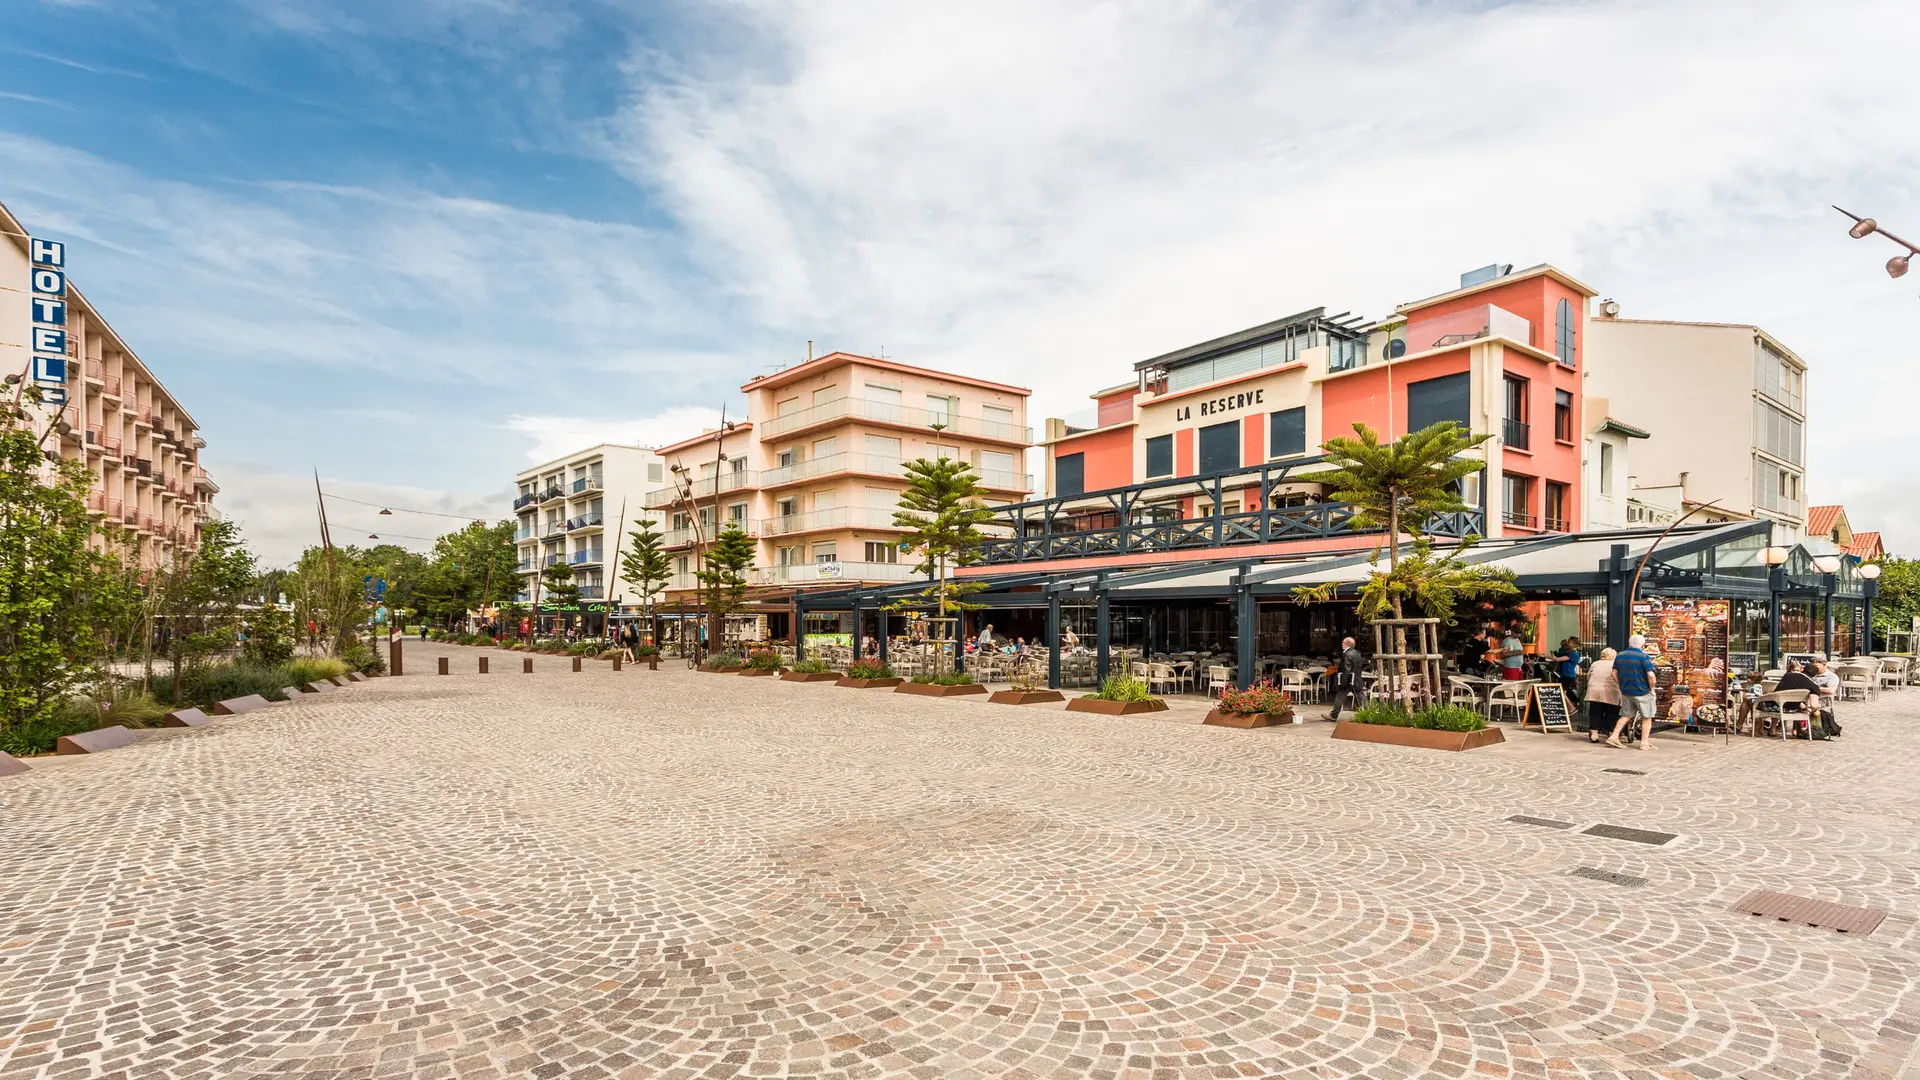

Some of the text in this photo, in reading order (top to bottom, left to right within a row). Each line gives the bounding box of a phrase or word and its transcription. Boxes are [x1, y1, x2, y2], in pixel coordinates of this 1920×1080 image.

[33, 240, 62, 382] HOTEL
[1177, 389, 1264, 421] LA RESERVE
